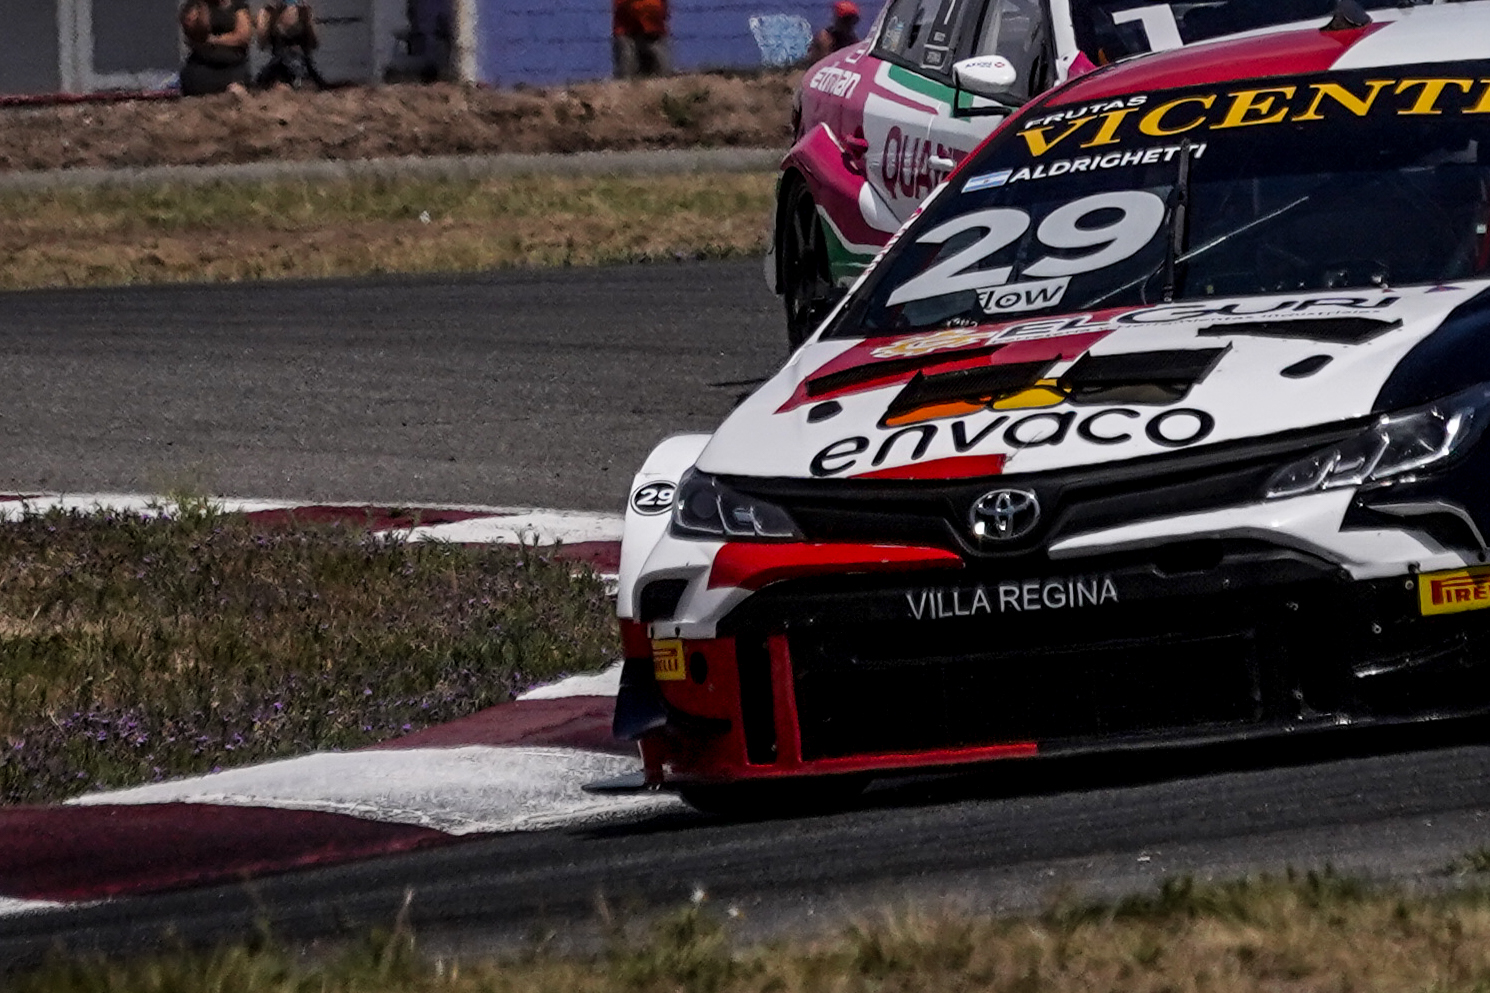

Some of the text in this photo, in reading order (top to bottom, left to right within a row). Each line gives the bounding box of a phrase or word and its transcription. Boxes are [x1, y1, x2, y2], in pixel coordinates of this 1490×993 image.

[1112, 4, 1184, 53] 1
[1024, 95, 1149, 130] FRUTAS
[886, 190, 1166, 307] 29
[809, 407, 1216, 478] envaco
[636, 488, 676, 506] 29
[906, 578, 1120, 621] VILLA REGINA
